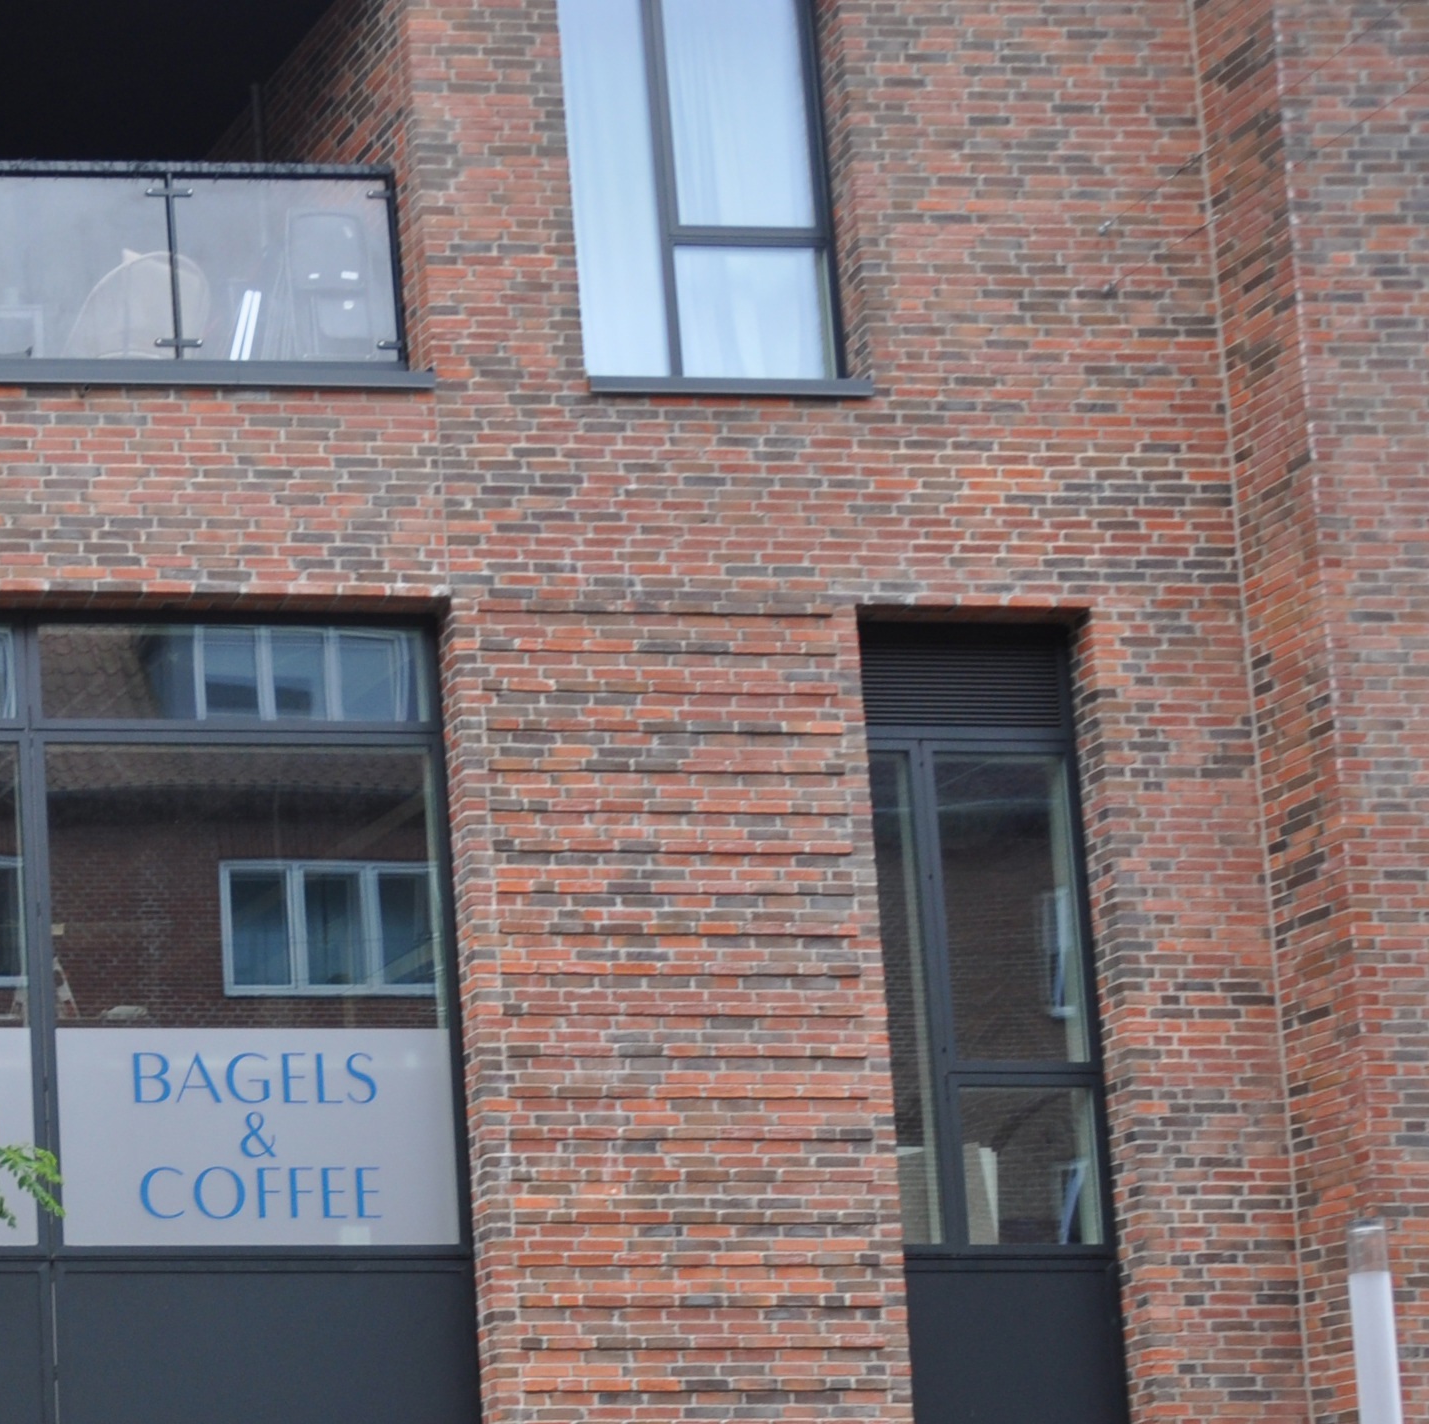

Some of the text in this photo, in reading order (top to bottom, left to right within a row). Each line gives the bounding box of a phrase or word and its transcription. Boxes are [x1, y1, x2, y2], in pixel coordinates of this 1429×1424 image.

[132, 1052, 377, 1104] BAGELS
[240, 1111, 277, 1159] &
[139, 1166, 383, 1220] COFFEE
